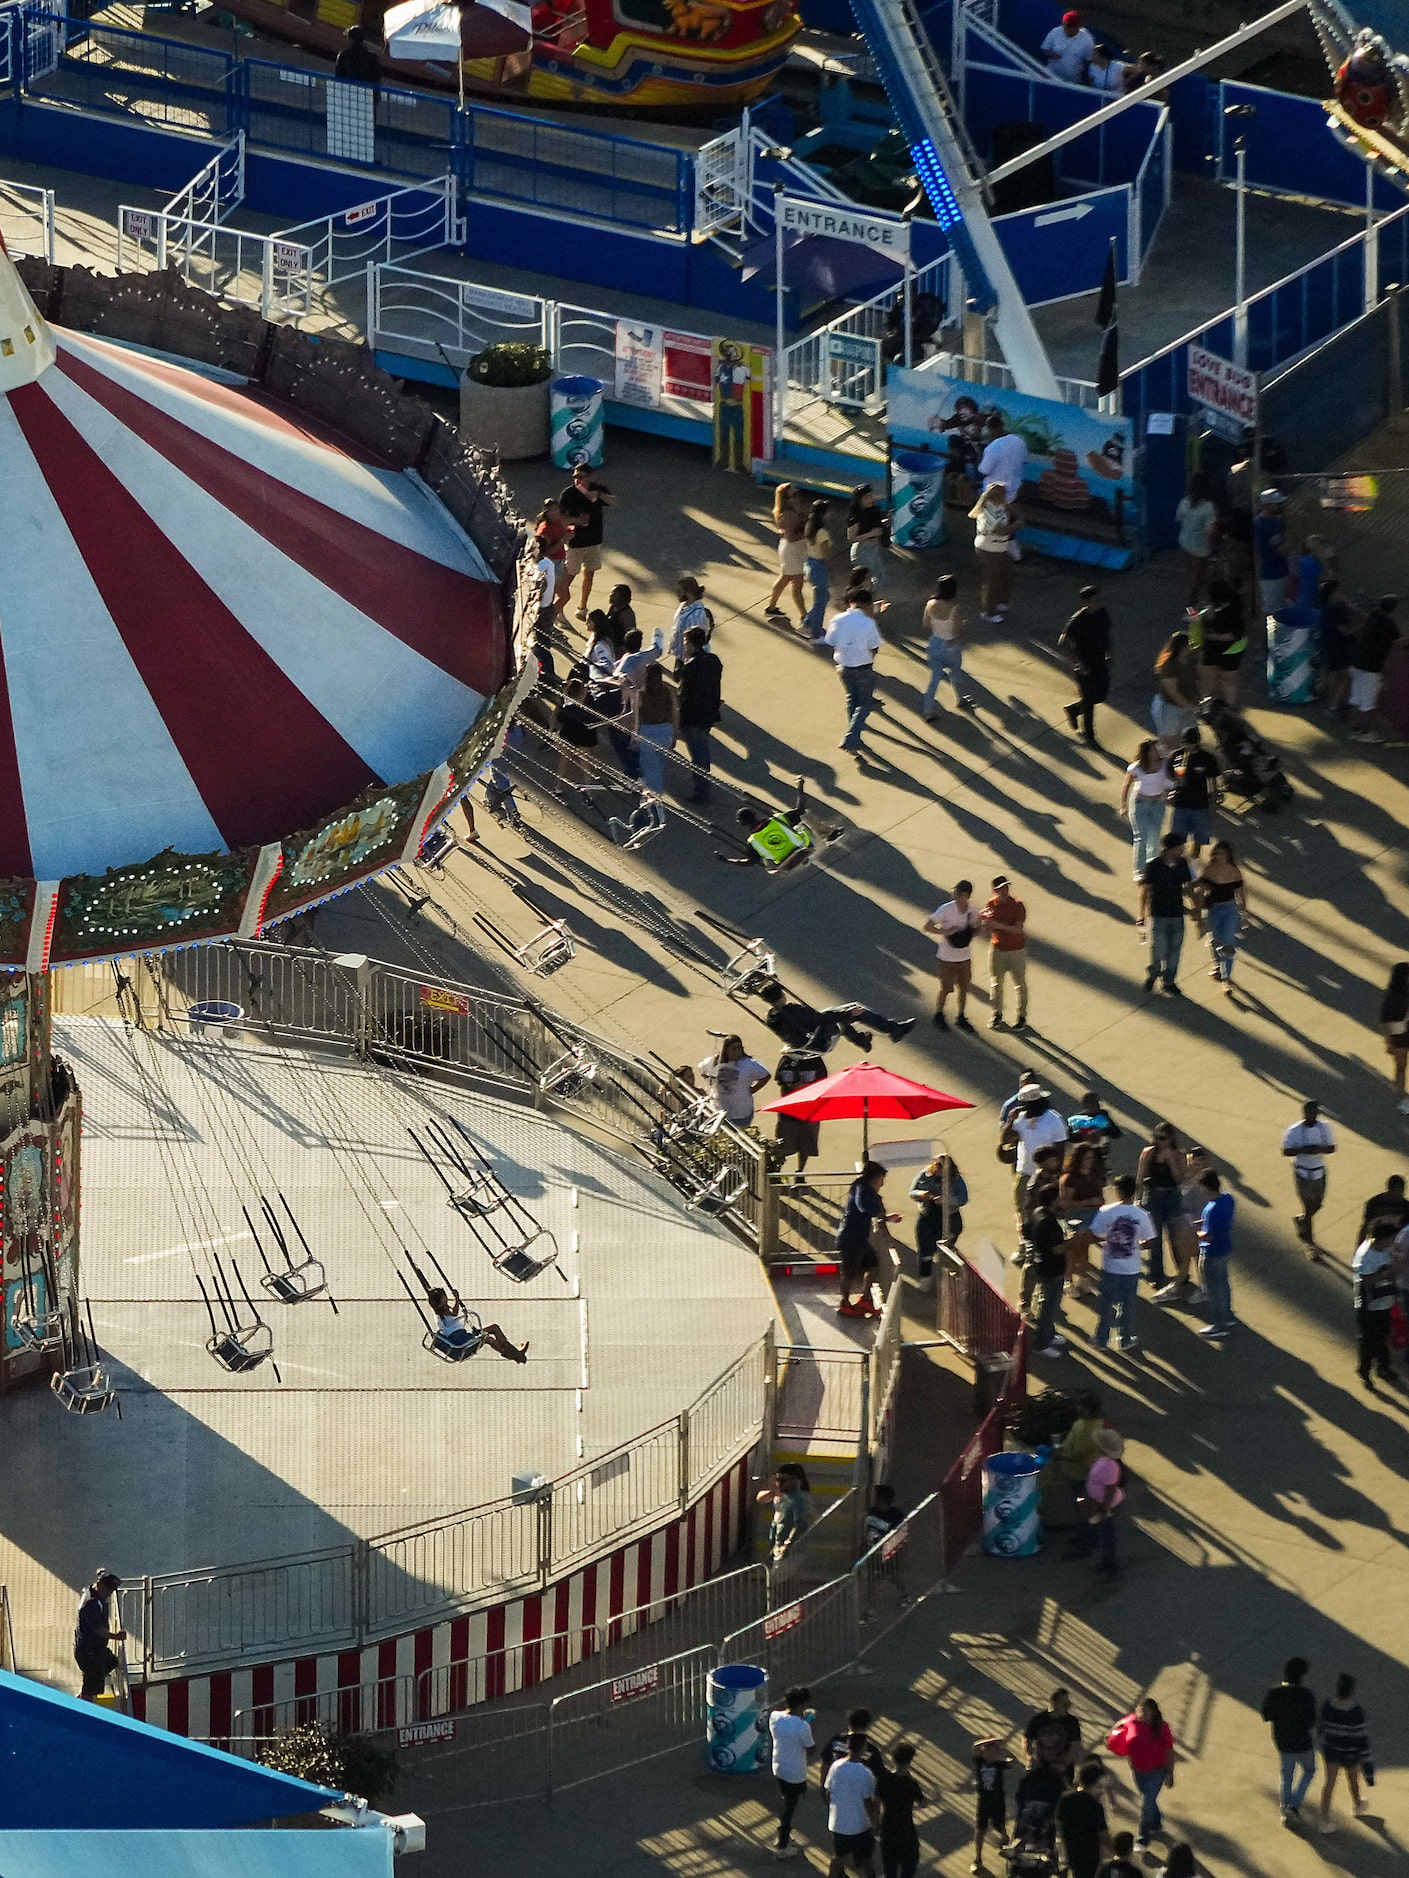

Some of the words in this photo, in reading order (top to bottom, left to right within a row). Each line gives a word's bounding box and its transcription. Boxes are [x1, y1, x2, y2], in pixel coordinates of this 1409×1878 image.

[130, 213, 148, 225] EXIT
[362, 205, 375, 218] EXIT
[129, 224, 149, 236] ONLY
[784, 207, 893, 245] ENTRANCE
[281, 246, 298, 258] EXIT
[279, 258, 300, 270] ONLY
[1189, 368, 1255, 420] ENTRANCE
[430, 989, 460, 1006] EXIT
[613, 1666, 658, 1696] ENTRANCE
[399, 1720, 454, 1743] ENTRANCE
